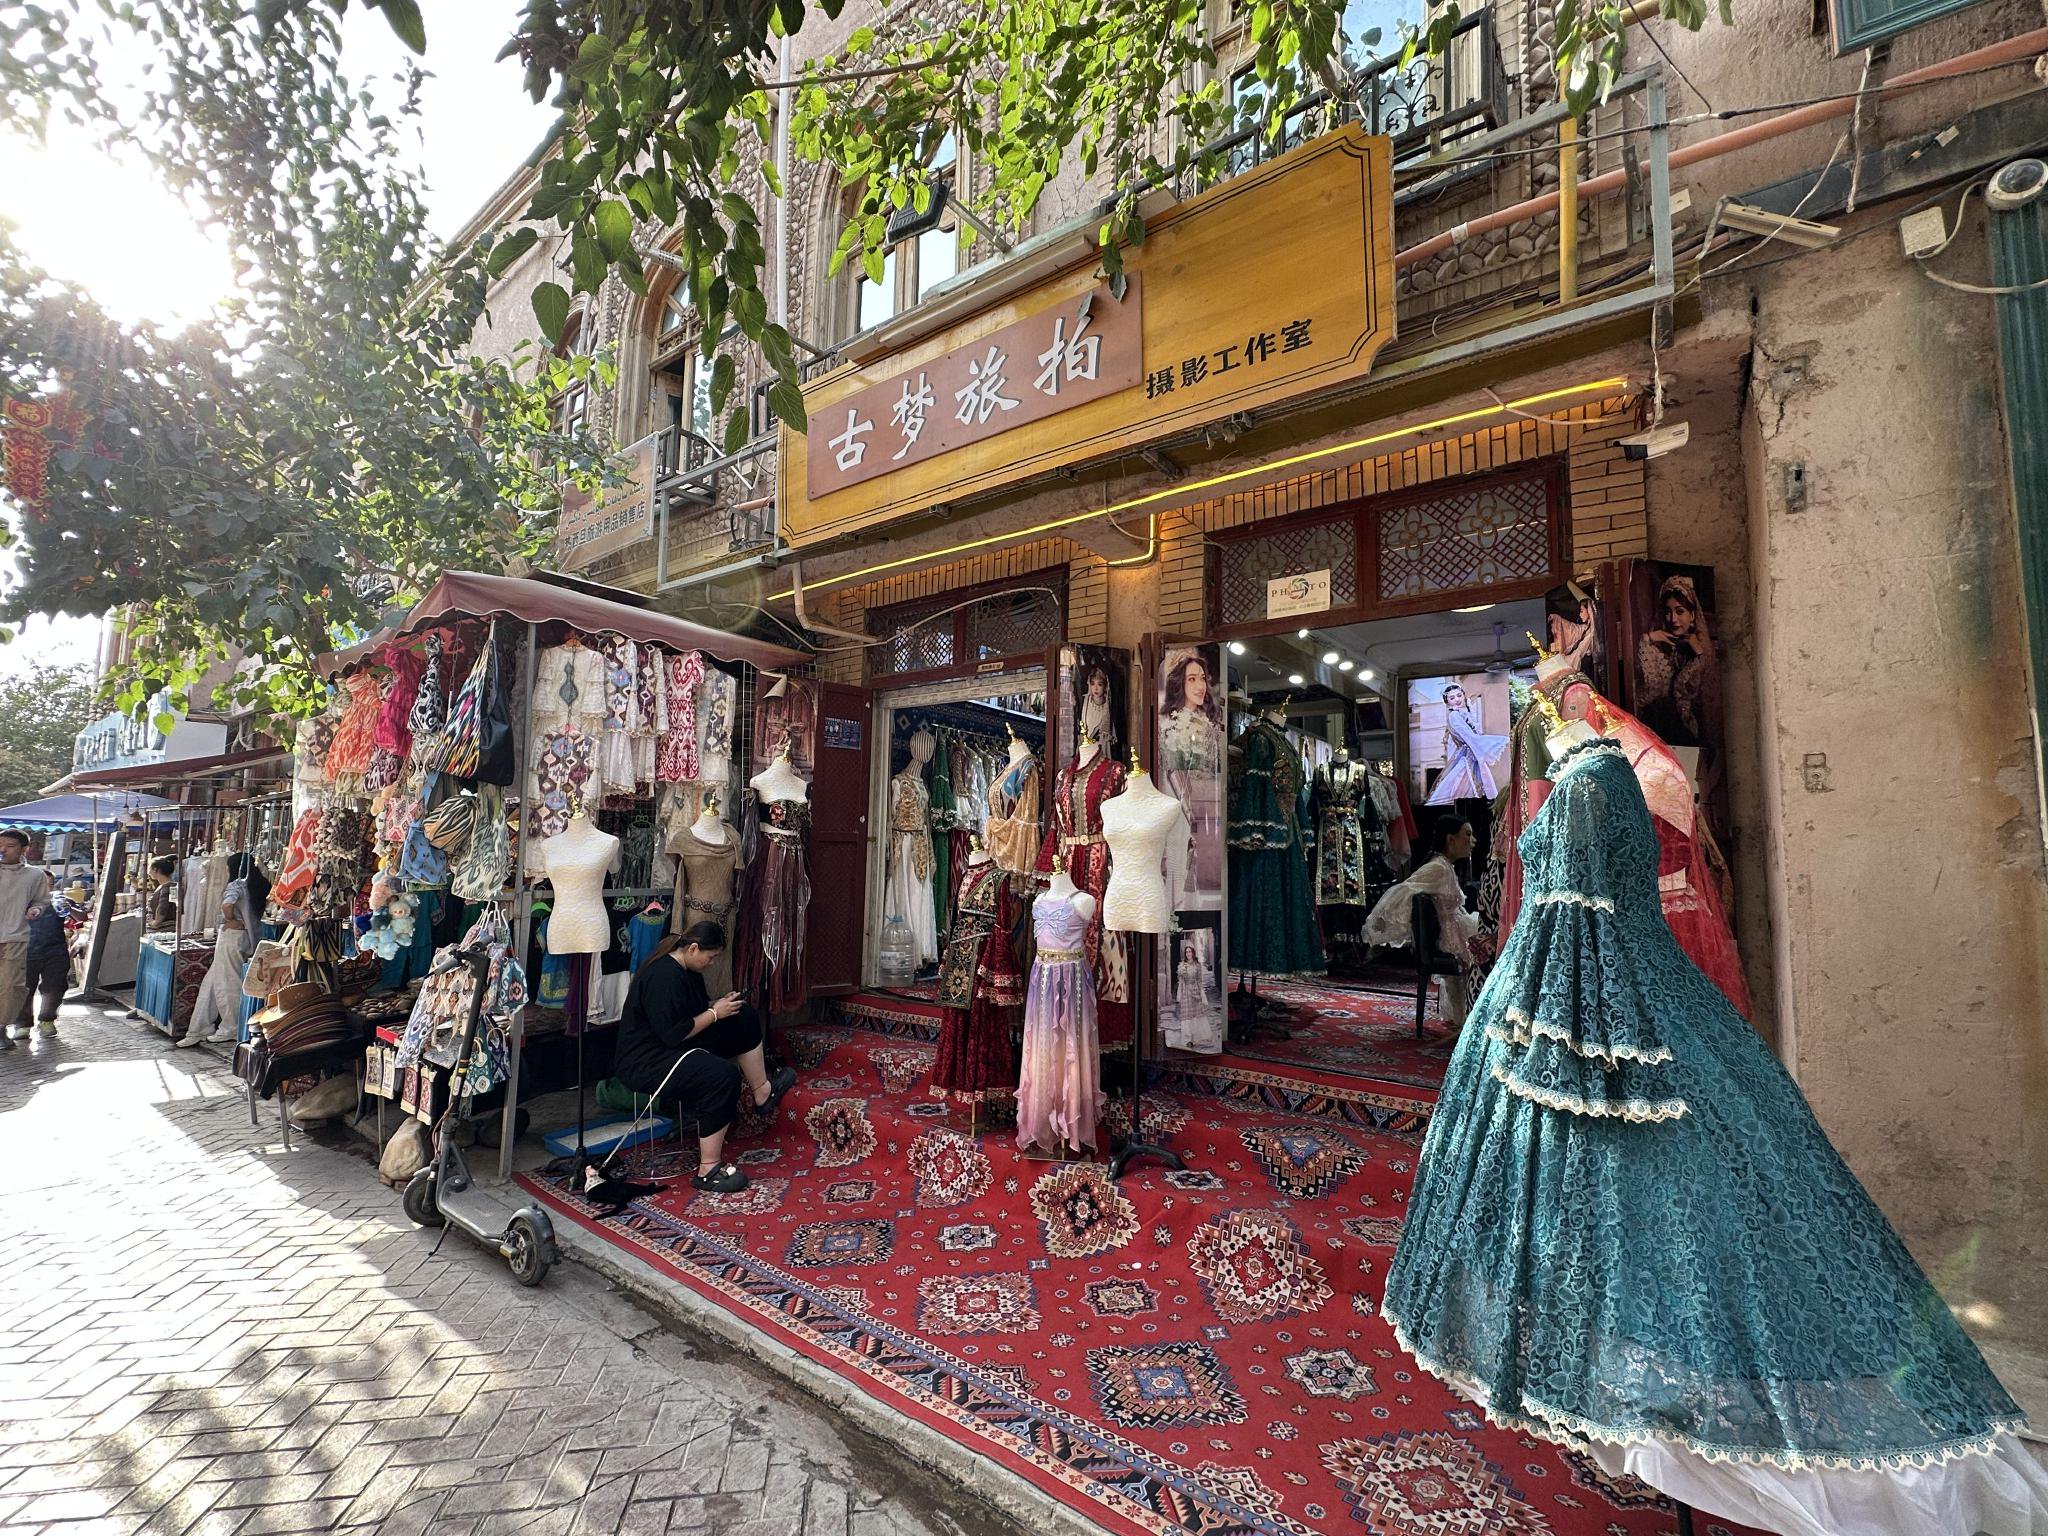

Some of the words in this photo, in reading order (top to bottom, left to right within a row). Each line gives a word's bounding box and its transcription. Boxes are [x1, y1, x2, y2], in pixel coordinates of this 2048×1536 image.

[828, 315, 1101, 473] 古梦旅拍
[1146, 318, 1313, 400] 摄影工作室
